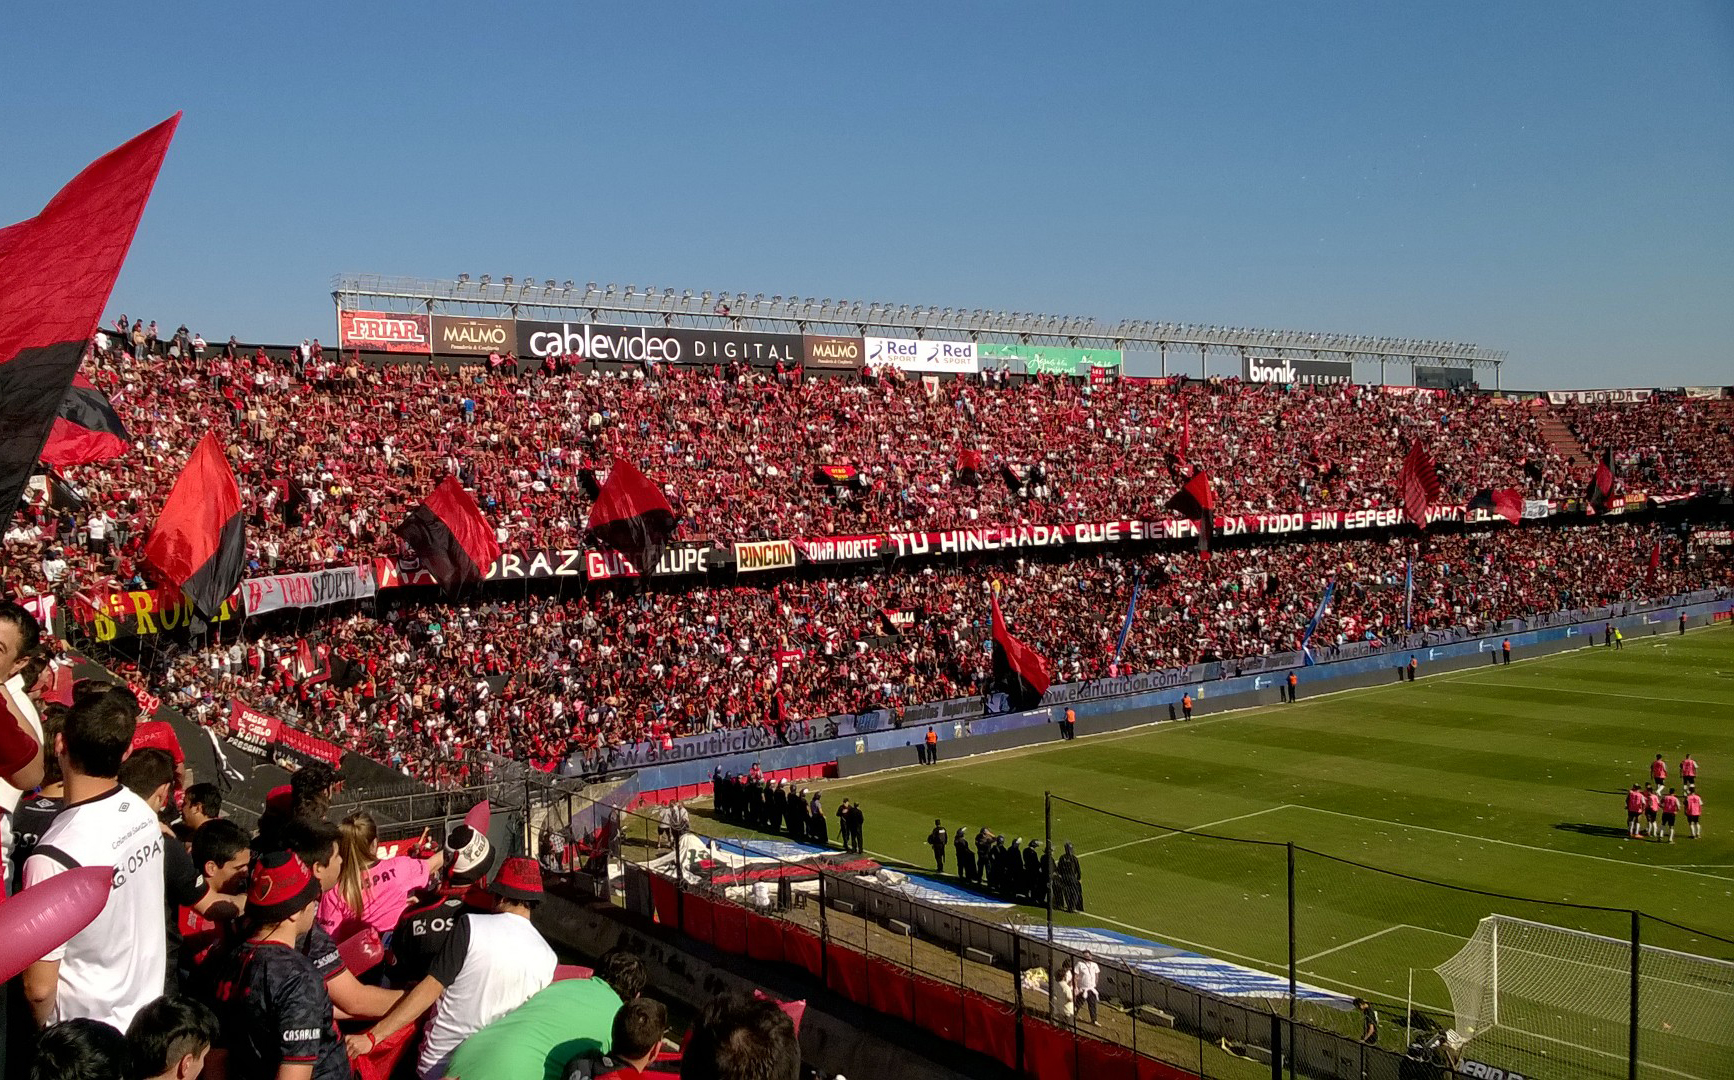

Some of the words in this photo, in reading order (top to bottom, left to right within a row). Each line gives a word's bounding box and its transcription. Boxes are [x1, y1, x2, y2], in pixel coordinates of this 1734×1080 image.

[349, 319, 424, 341] FRIAR
[443, 324, 506, 343] MALMÖ
[529, 323, 680, 361] cablevideo
[694, 341, 794, 360] DIGITAL
[812, 342, 858, 358] MALMÖ
[887, 341, 917, 355] Red
[943, 344, 972, 357] Red
[888, 354, 917, 362] SPORT
[1249, 358, 1297, 383] bionik
[1297, 375, 1351, 384] INTERNET
[940, 526, 1064, 552] HINCHADA
[1075, 522, 1120, 543] QUE
[1223, 516, 1247, 535] DA
[1256, 513, 1304, 533] TODO
[1310, 511, 1338, 529] SIN
[738, 543, 793, 568] RINCON
[836, 538, 878, 559] NORTE
[588, 547, 711, 578] GUALUPE
[275, 570, 356, 605] TRANSPORTE
[128, 591, 230, 635] ROM
[242, 711, 268, 726] DESDE
[226, 736, 267, 757] PRESENTE
[127, 835, 163, 874] OSPA
